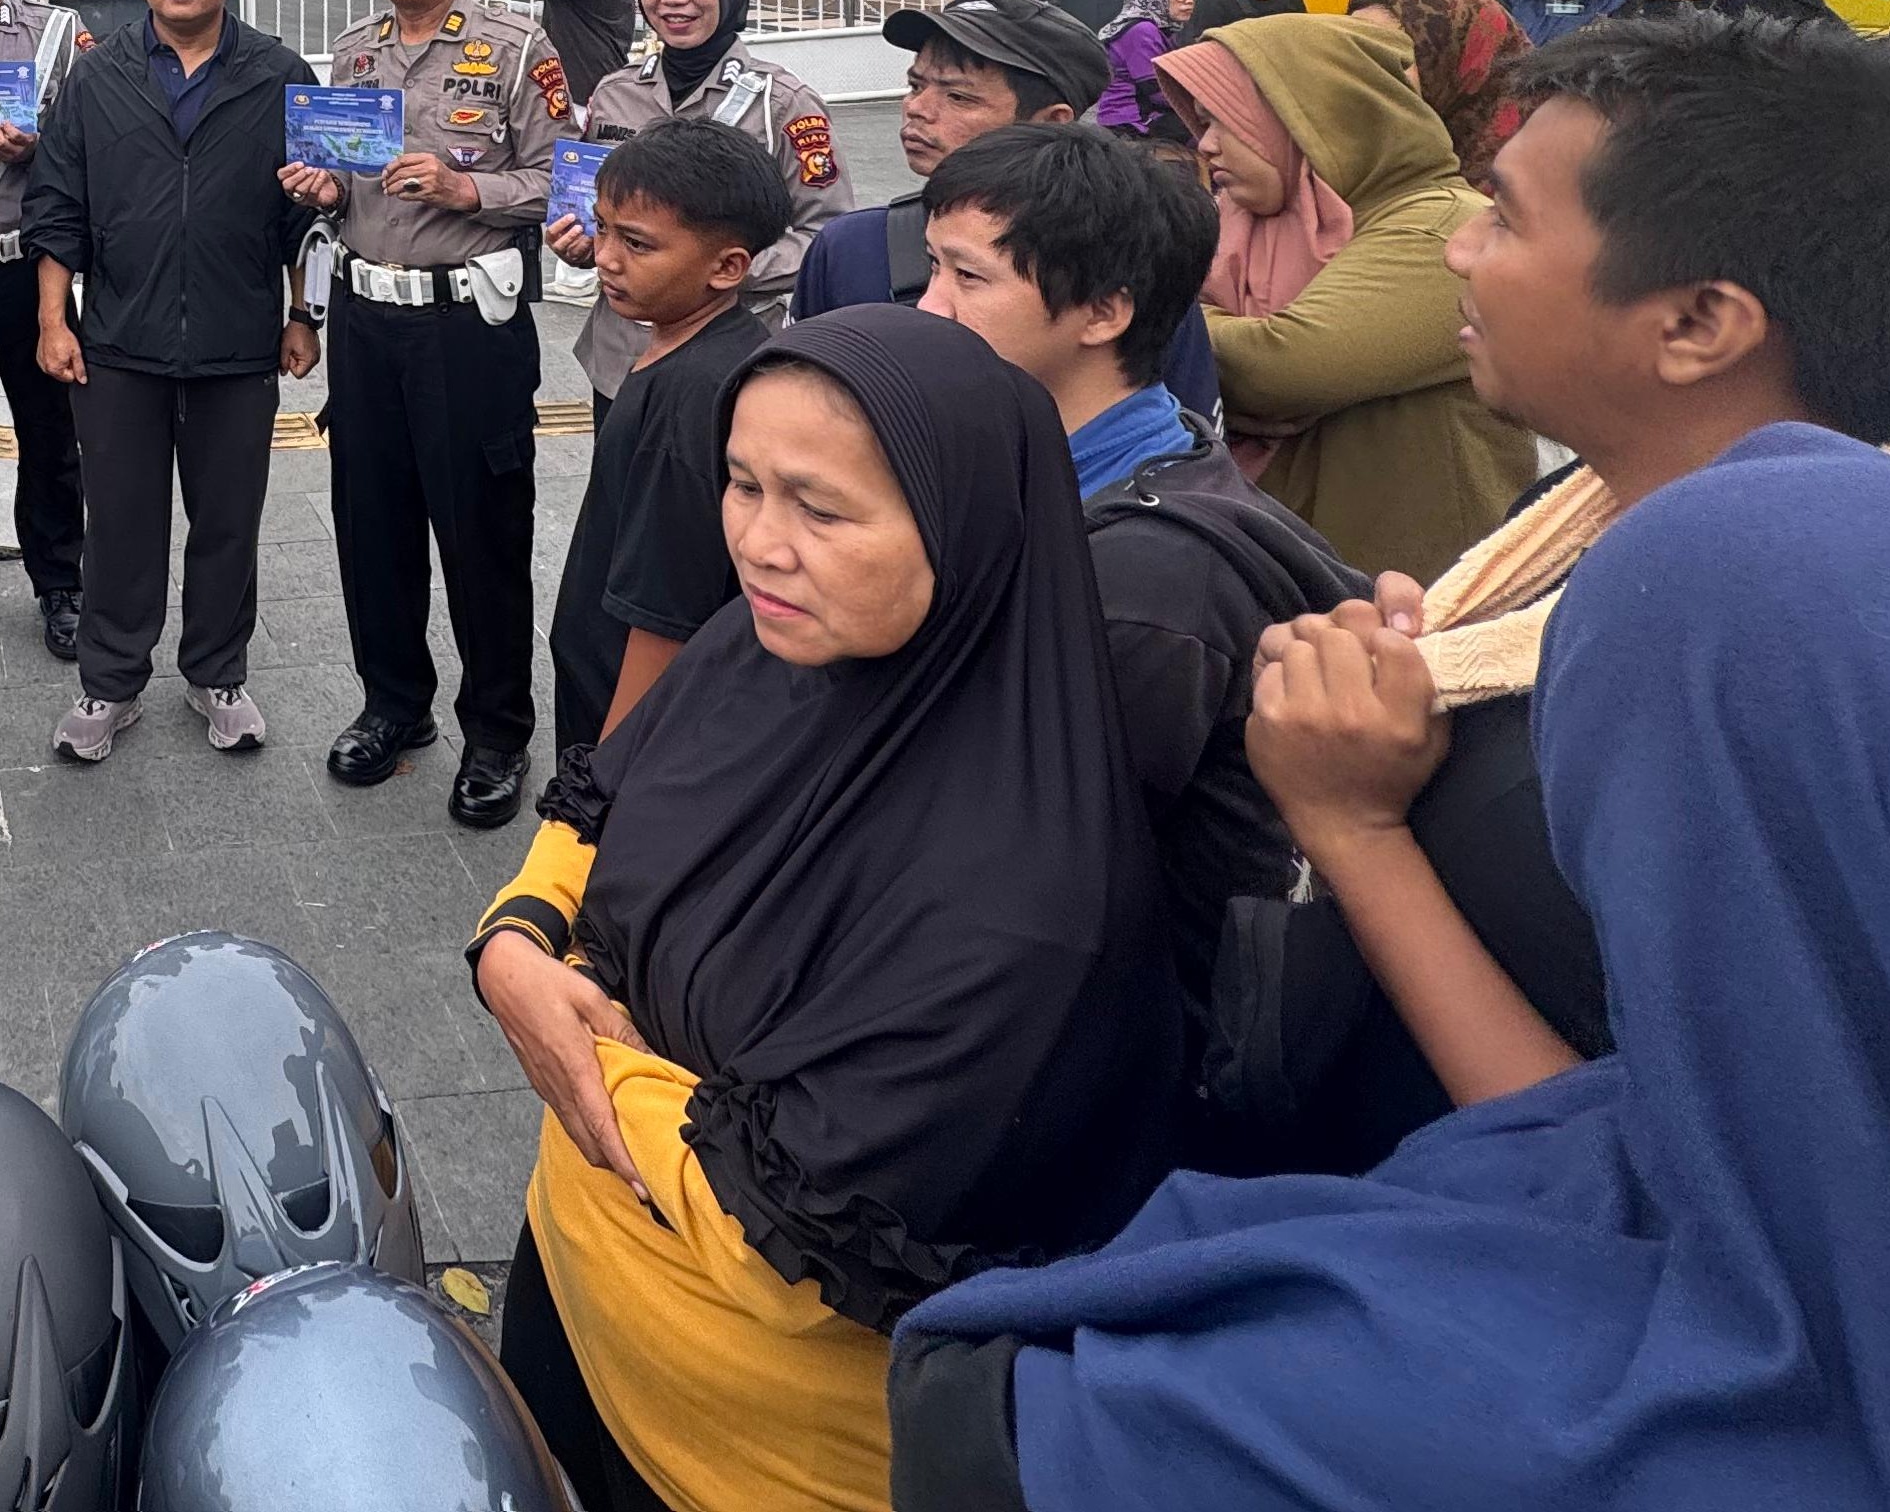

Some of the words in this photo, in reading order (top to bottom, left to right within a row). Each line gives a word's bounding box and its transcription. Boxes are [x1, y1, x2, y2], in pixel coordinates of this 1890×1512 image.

[443, 78, 501, 100] POLRI
[790, 117, 826, 135] POLDA
[798, 133, 828, 147] RIAU
